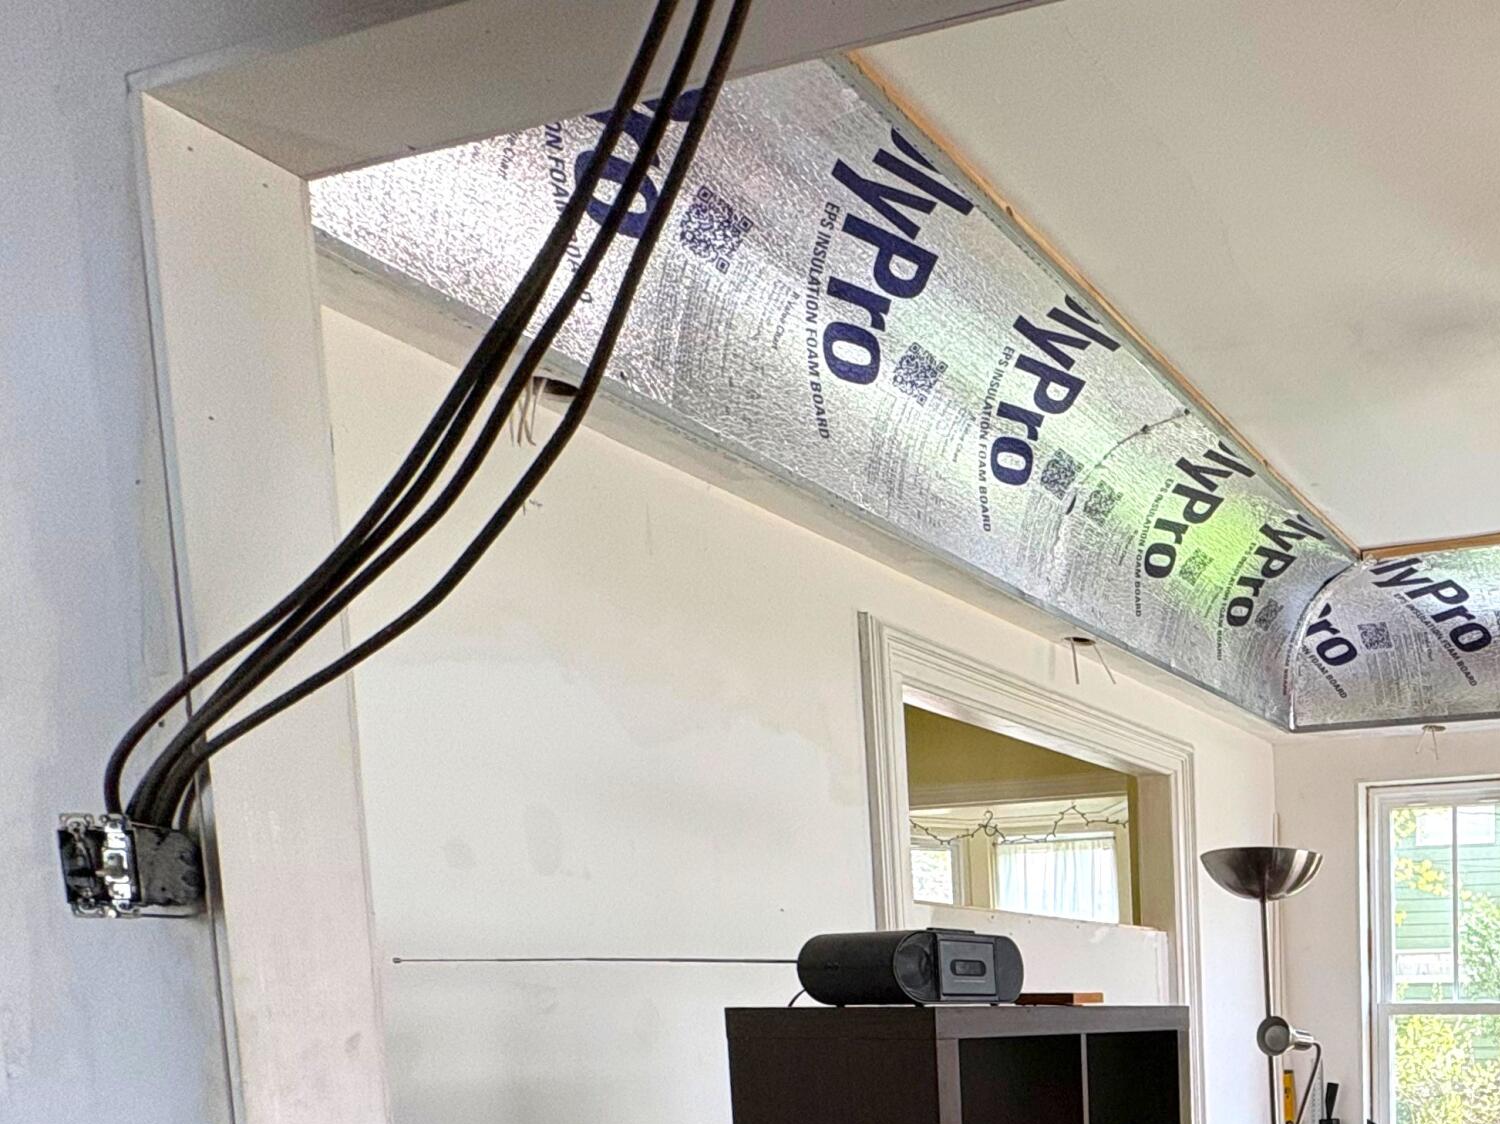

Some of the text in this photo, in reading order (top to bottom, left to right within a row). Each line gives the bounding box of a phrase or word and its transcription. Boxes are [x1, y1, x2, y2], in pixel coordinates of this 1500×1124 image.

[805, 201, 840, 440] EPS INSULATION FOAM BOARD
[977, 345, 1016, 533] EPS INSULATION FOAM BOARD
[990, 294, 1122, 486] lyPro
[1144, 440, 1256, 578] lyPro
[1227, 514, 1326, 627] lyPro
[1134, 581, 1142, 618] BOARD
[1369, 557, 1492, 652] lyPro
[1456, 660, 1478, 687] BOARD
